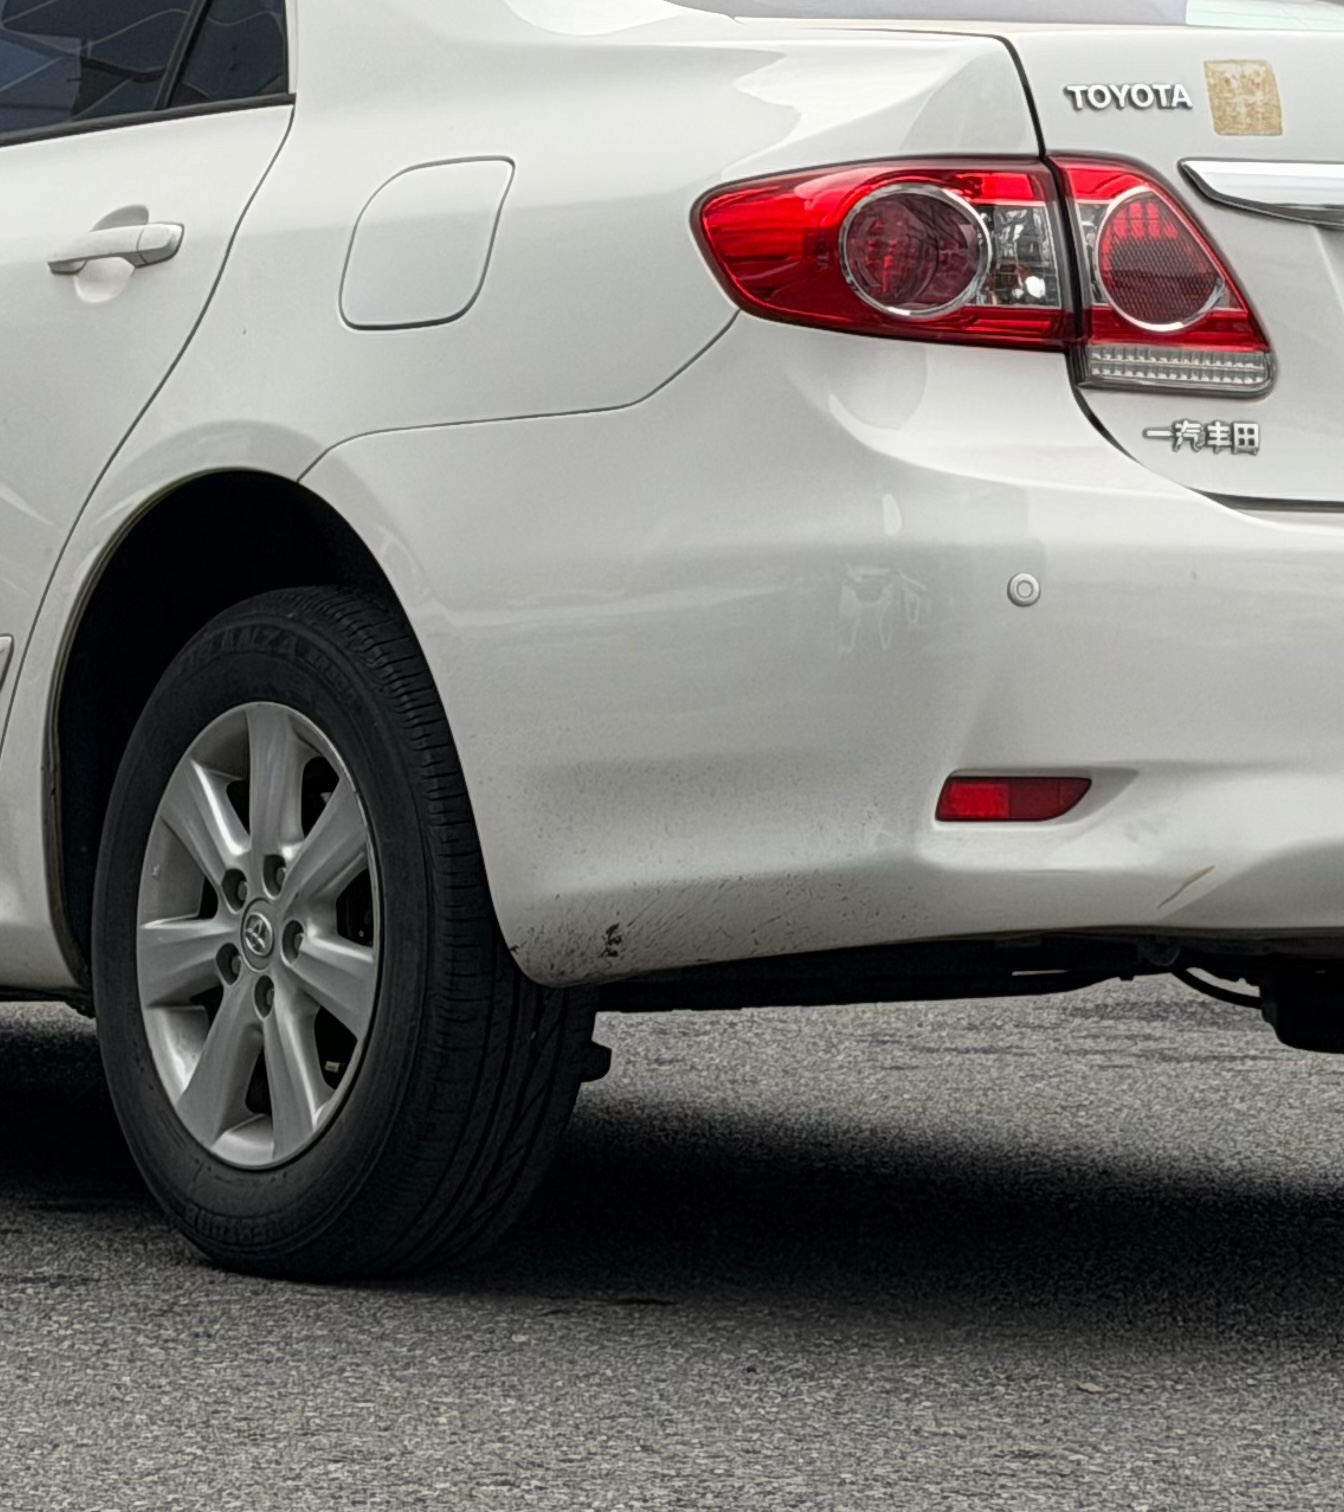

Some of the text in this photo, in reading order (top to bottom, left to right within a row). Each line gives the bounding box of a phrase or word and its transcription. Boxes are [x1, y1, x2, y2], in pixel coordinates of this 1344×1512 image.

[1063, 83, 1193, 111] TOYOTA
[1143, 418, 1260, 455] 一汽丰田
